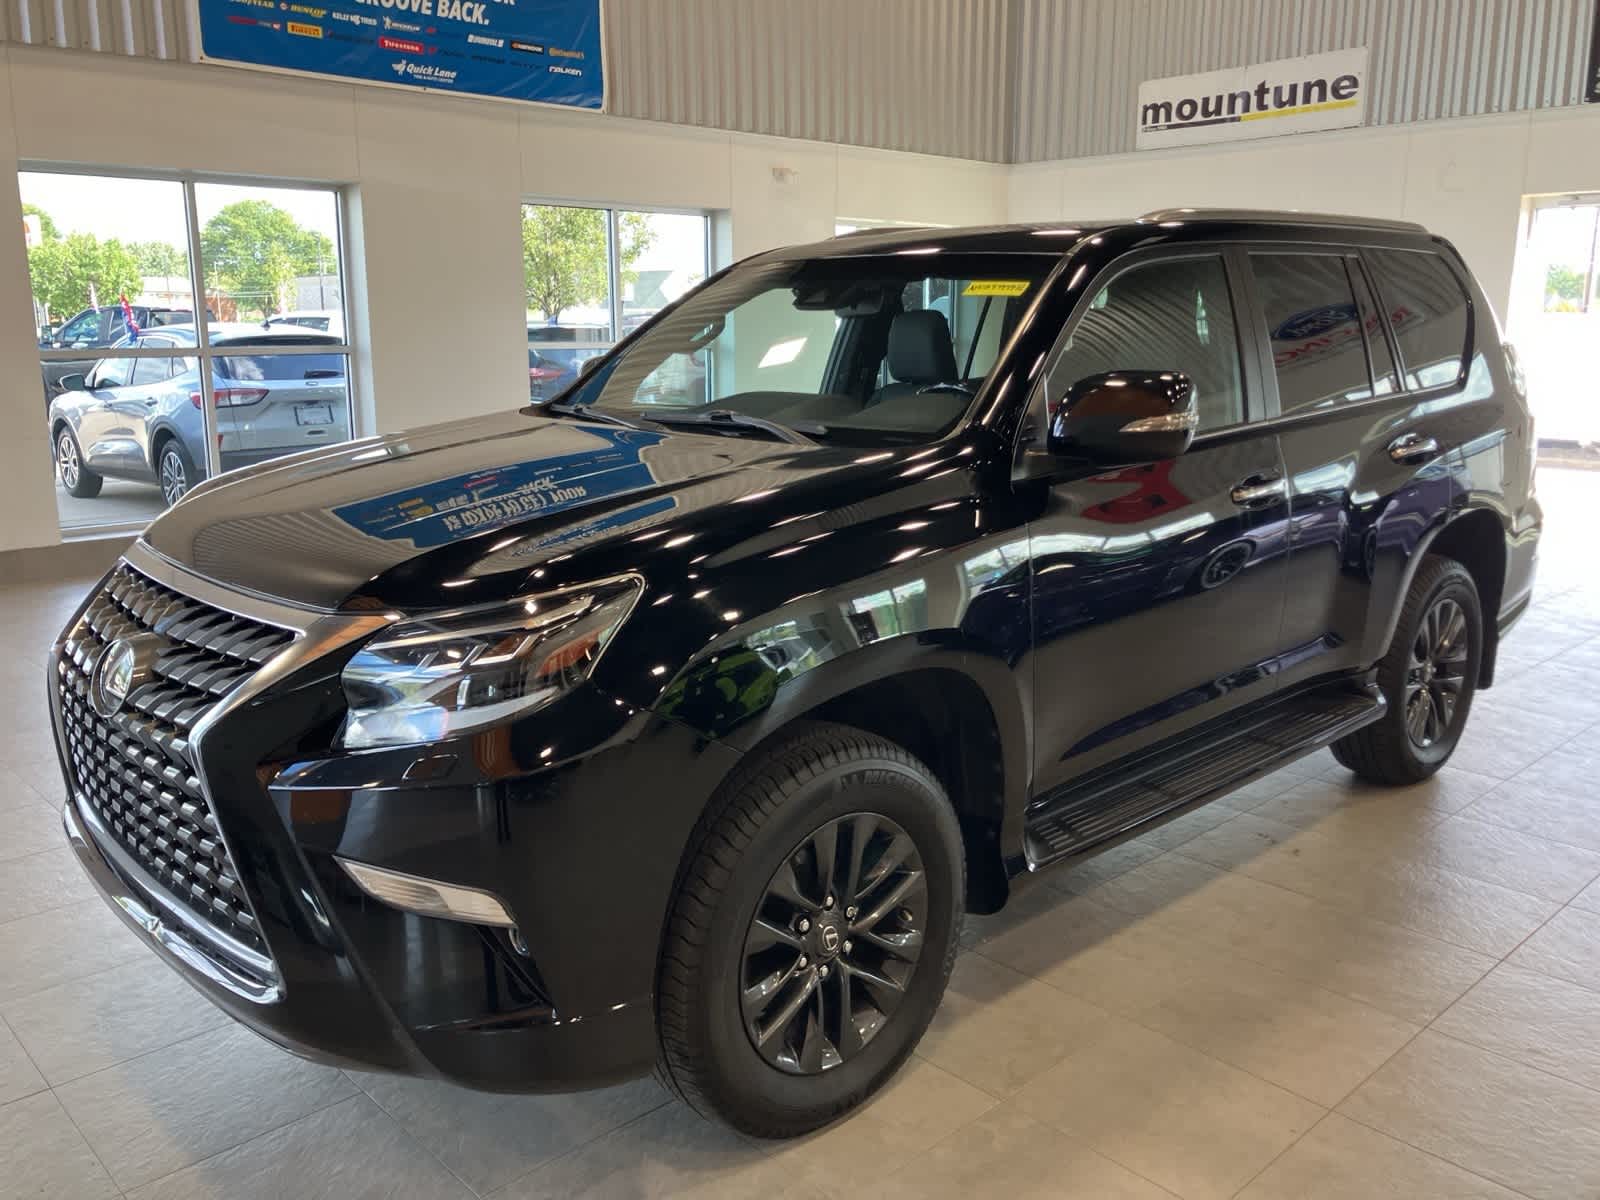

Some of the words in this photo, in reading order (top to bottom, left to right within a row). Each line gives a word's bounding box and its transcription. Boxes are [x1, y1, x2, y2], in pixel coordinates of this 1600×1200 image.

[231, 0, 274, 9] DYEAR
[290, 5, 327, 18] DUNLOP
[355, 0, 432, 15] OVE
[437, 0, 490, 25] BACK.
[406, 63, 434, 75] Quick
[434, 66, 457, 78] Lane
[1141, 74, 1359, 125] mountune
